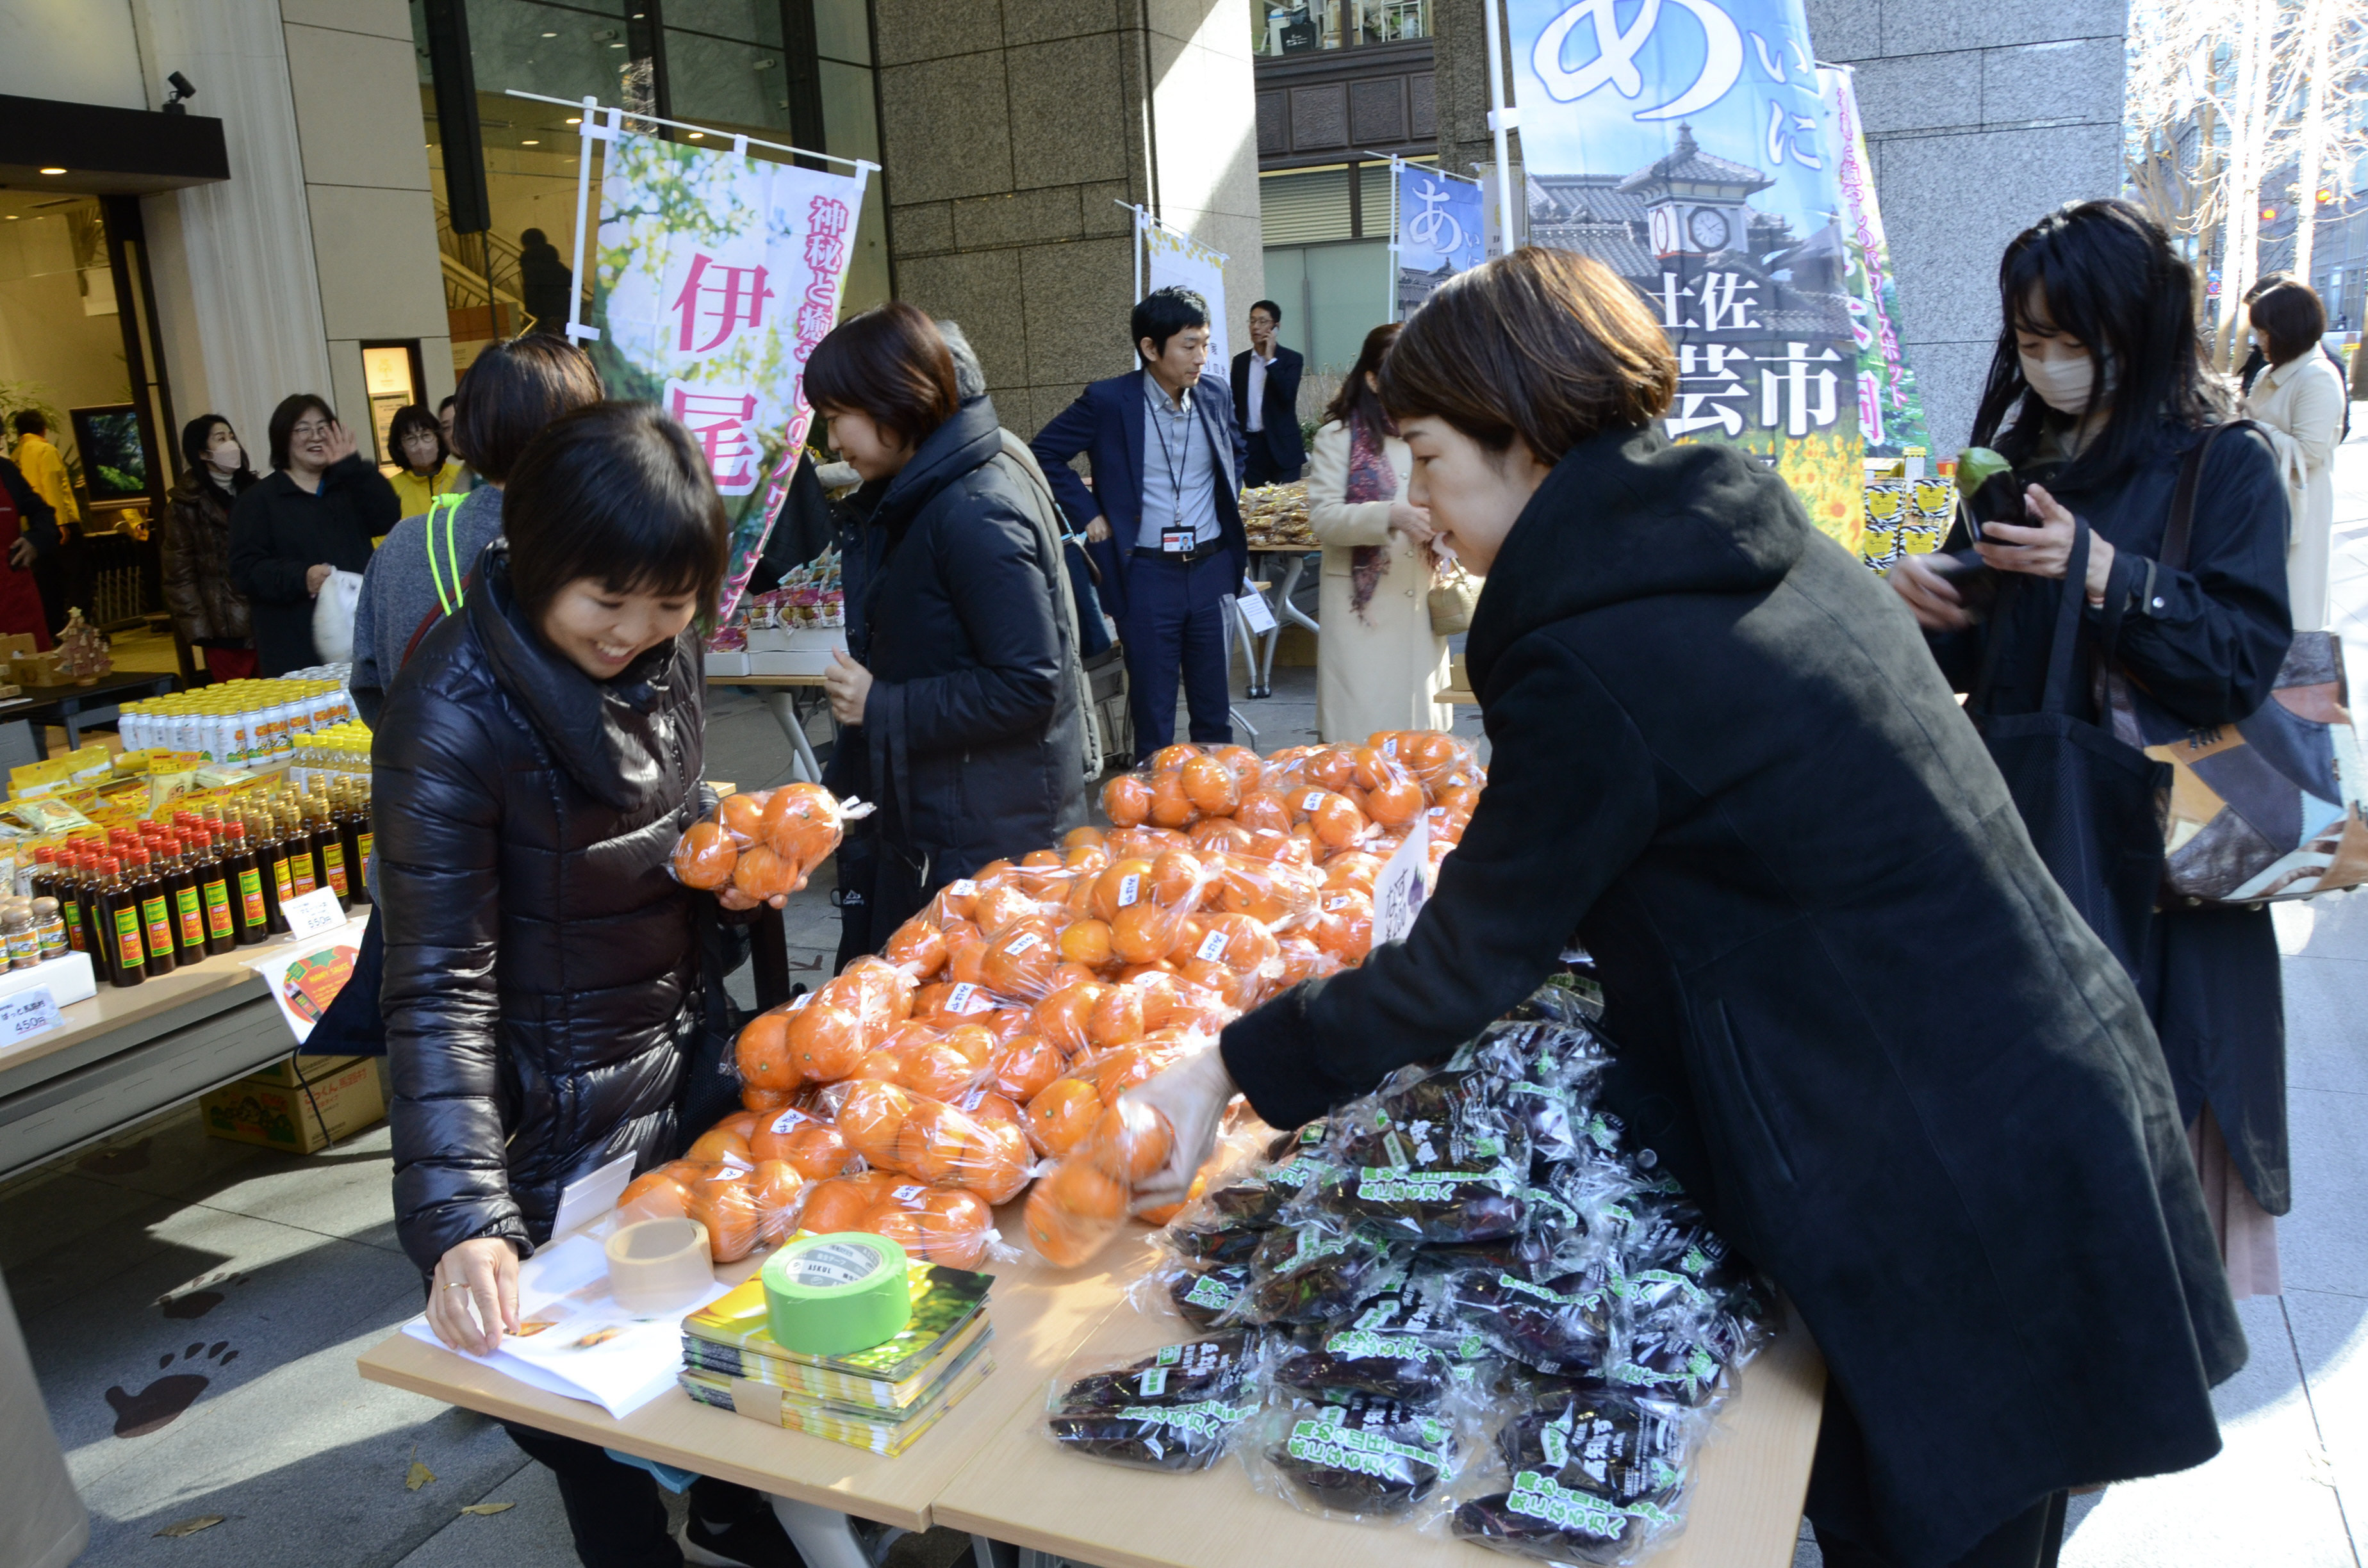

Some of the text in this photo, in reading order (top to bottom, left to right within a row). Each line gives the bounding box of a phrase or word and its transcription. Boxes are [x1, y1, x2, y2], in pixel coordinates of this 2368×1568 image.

[1410, 178, 1462, 254] あ
[1647, 272, 1762, 332] 土佐
[807, 1264, 831, 1275] ASKUL
[1288, 1437, 1399, 1482] 気になる方へ
[1506, 1490, 1628, 1540] 気になる方へ
